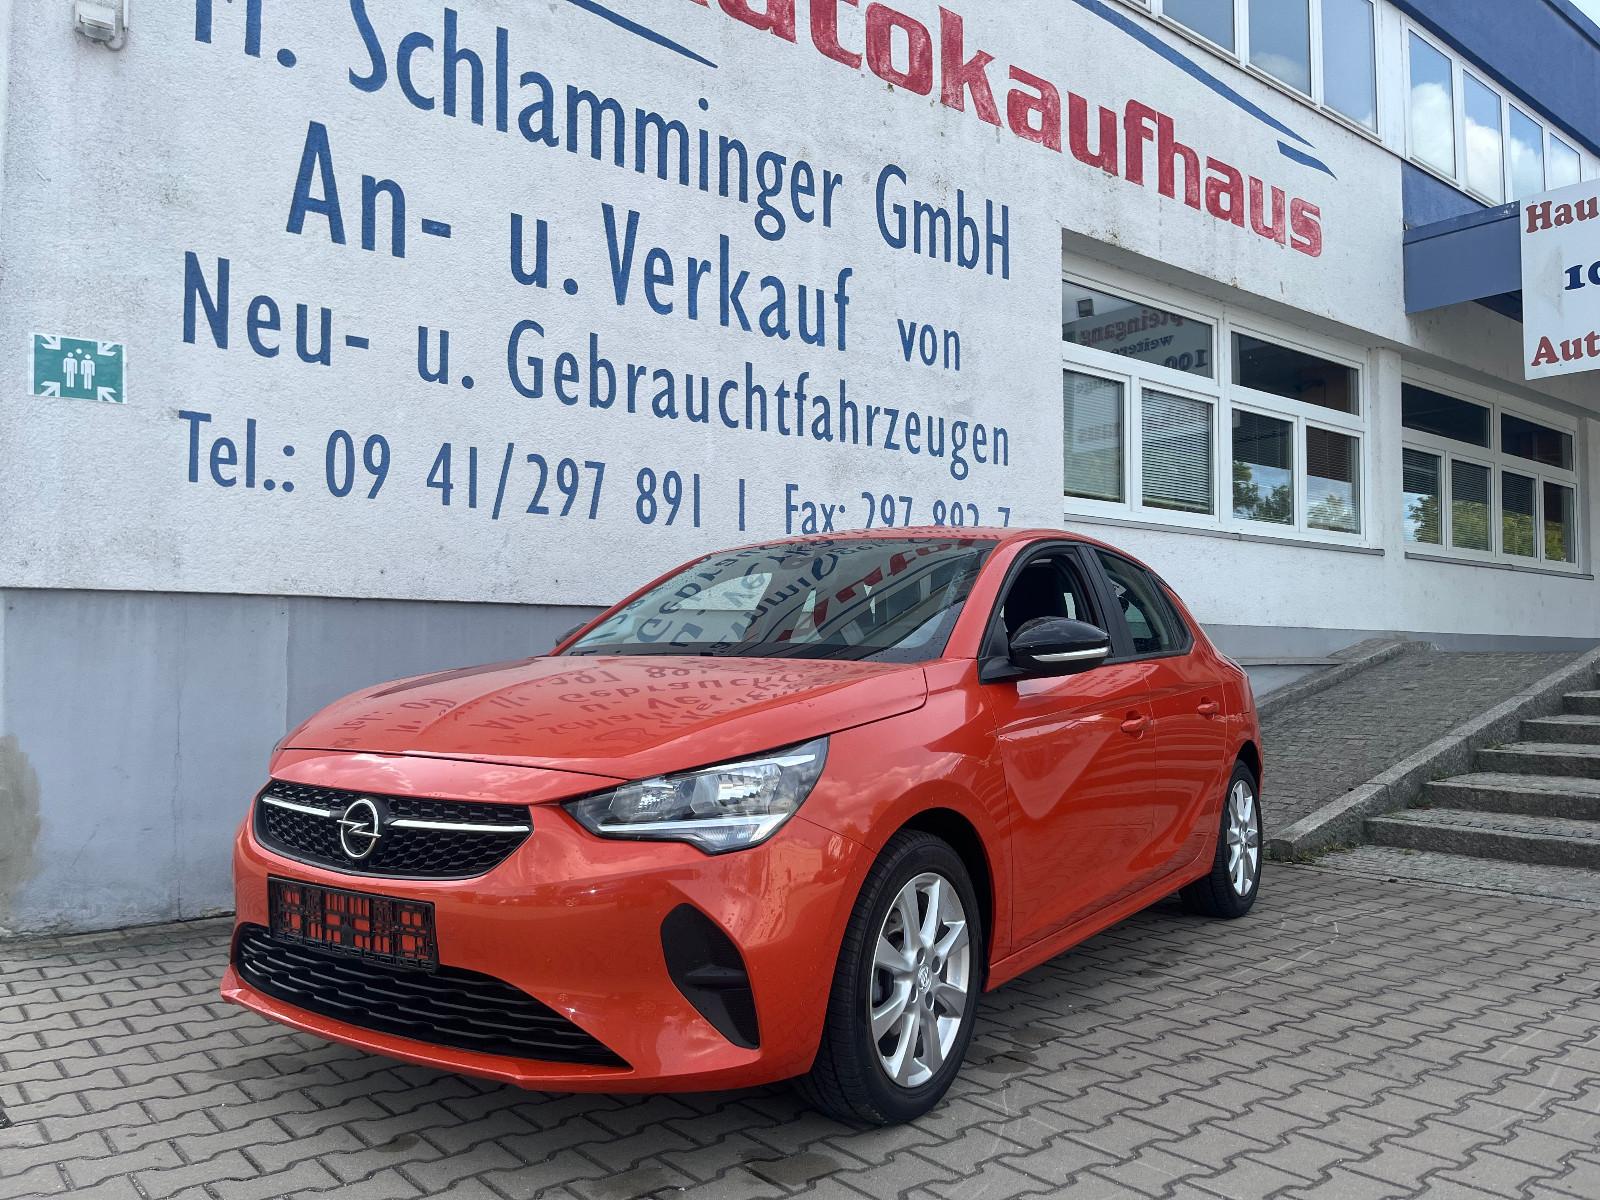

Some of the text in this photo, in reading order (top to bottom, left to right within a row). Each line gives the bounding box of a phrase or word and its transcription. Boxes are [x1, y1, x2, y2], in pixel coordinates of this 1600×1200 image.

[348, 0, 843, 241] Schlamminger
[876, 164, 1010, 280] GmbH
[682, 0, 1324, 259] tokaufhaus
[1526, 196, 1600, 234] Hau
[287, 121, 961, 371] An- u. Verkauf von
[1531, 330, 1600, 367] Aut
[183, 251, 1010, 481] Neu- u. Gebrauchtfahrzeugen
[325, 429, 391, 500] 09
[635, 466, 701, 529] 891
